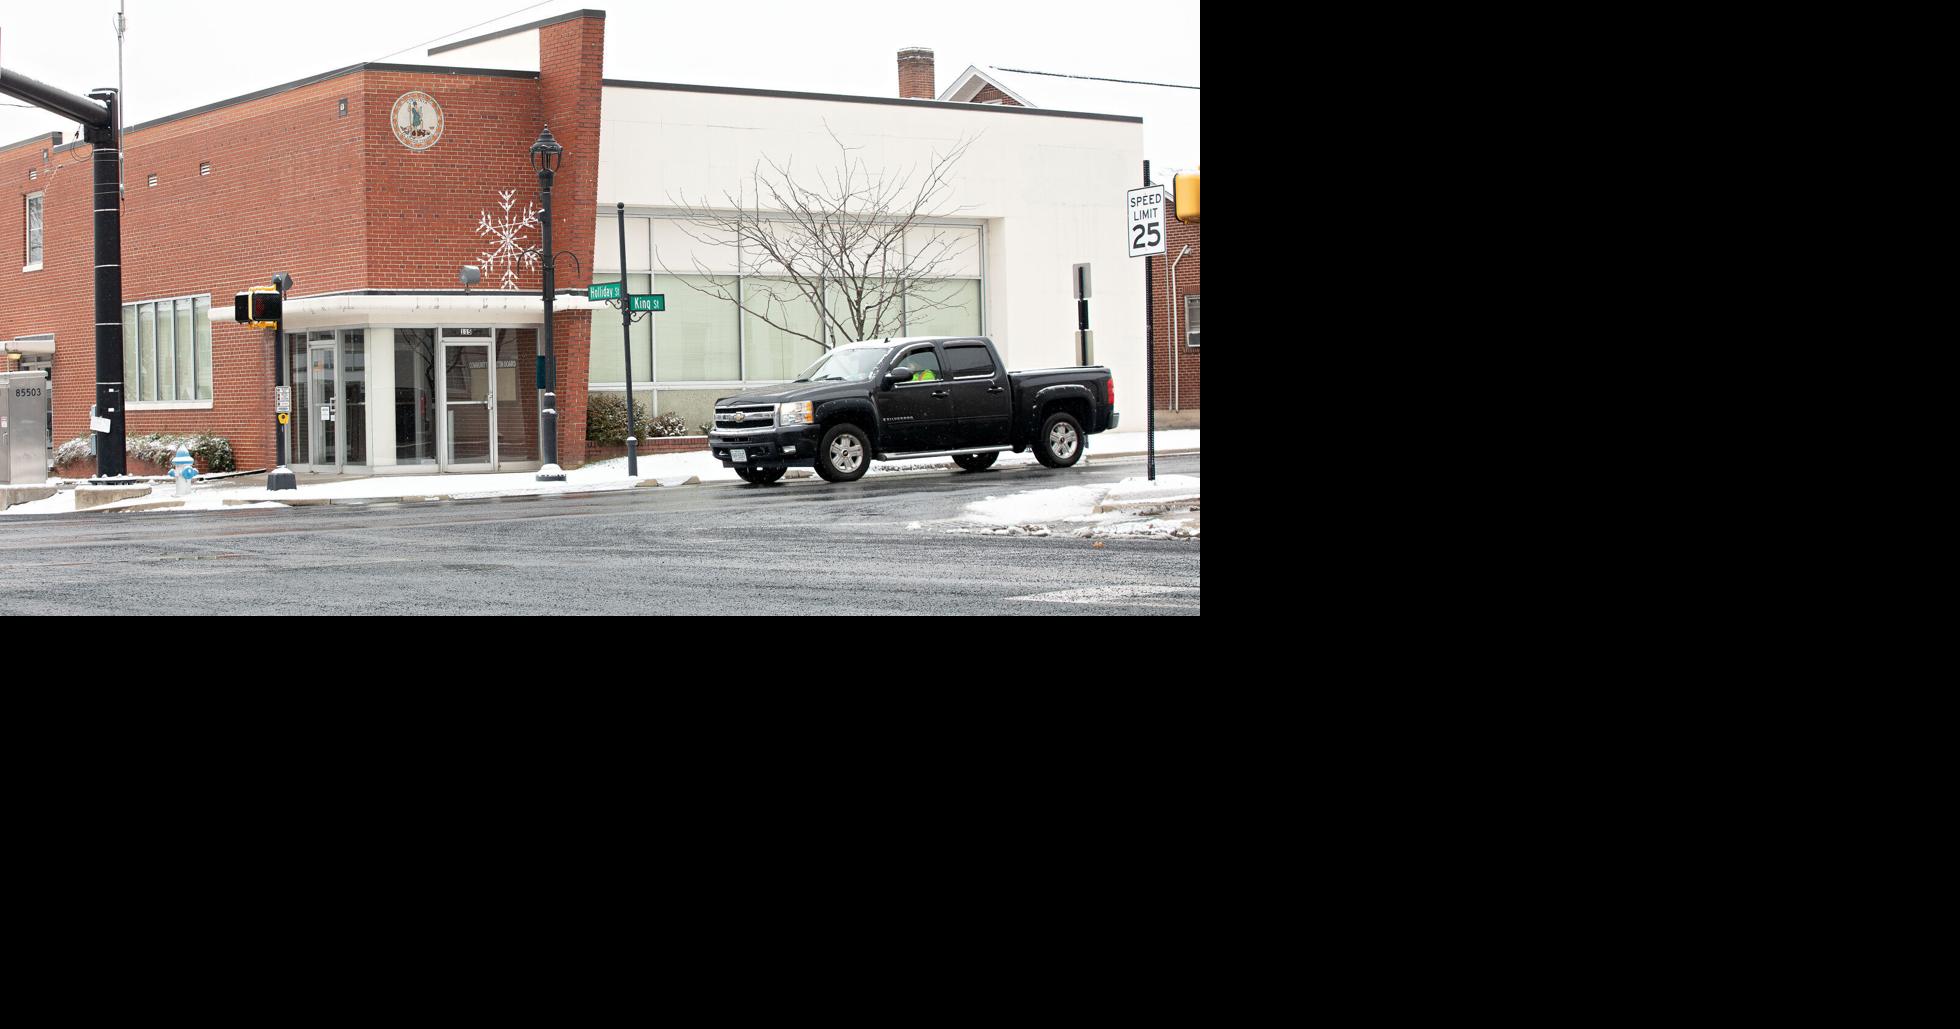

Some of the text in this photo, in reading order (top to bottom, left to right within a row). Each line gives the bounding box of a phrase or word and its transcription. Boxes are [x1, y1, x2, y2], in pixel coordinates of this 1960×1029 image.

[1130, 193, 1162, 208] SPEED
[1133, 207, 1158, 221] LIMIT
[1132, 221, 1161, 249] 25
[590, 284, 613, 299] Holliday
[634, 297, 651, 310] King
[15, 387, 42, 397] 85503
